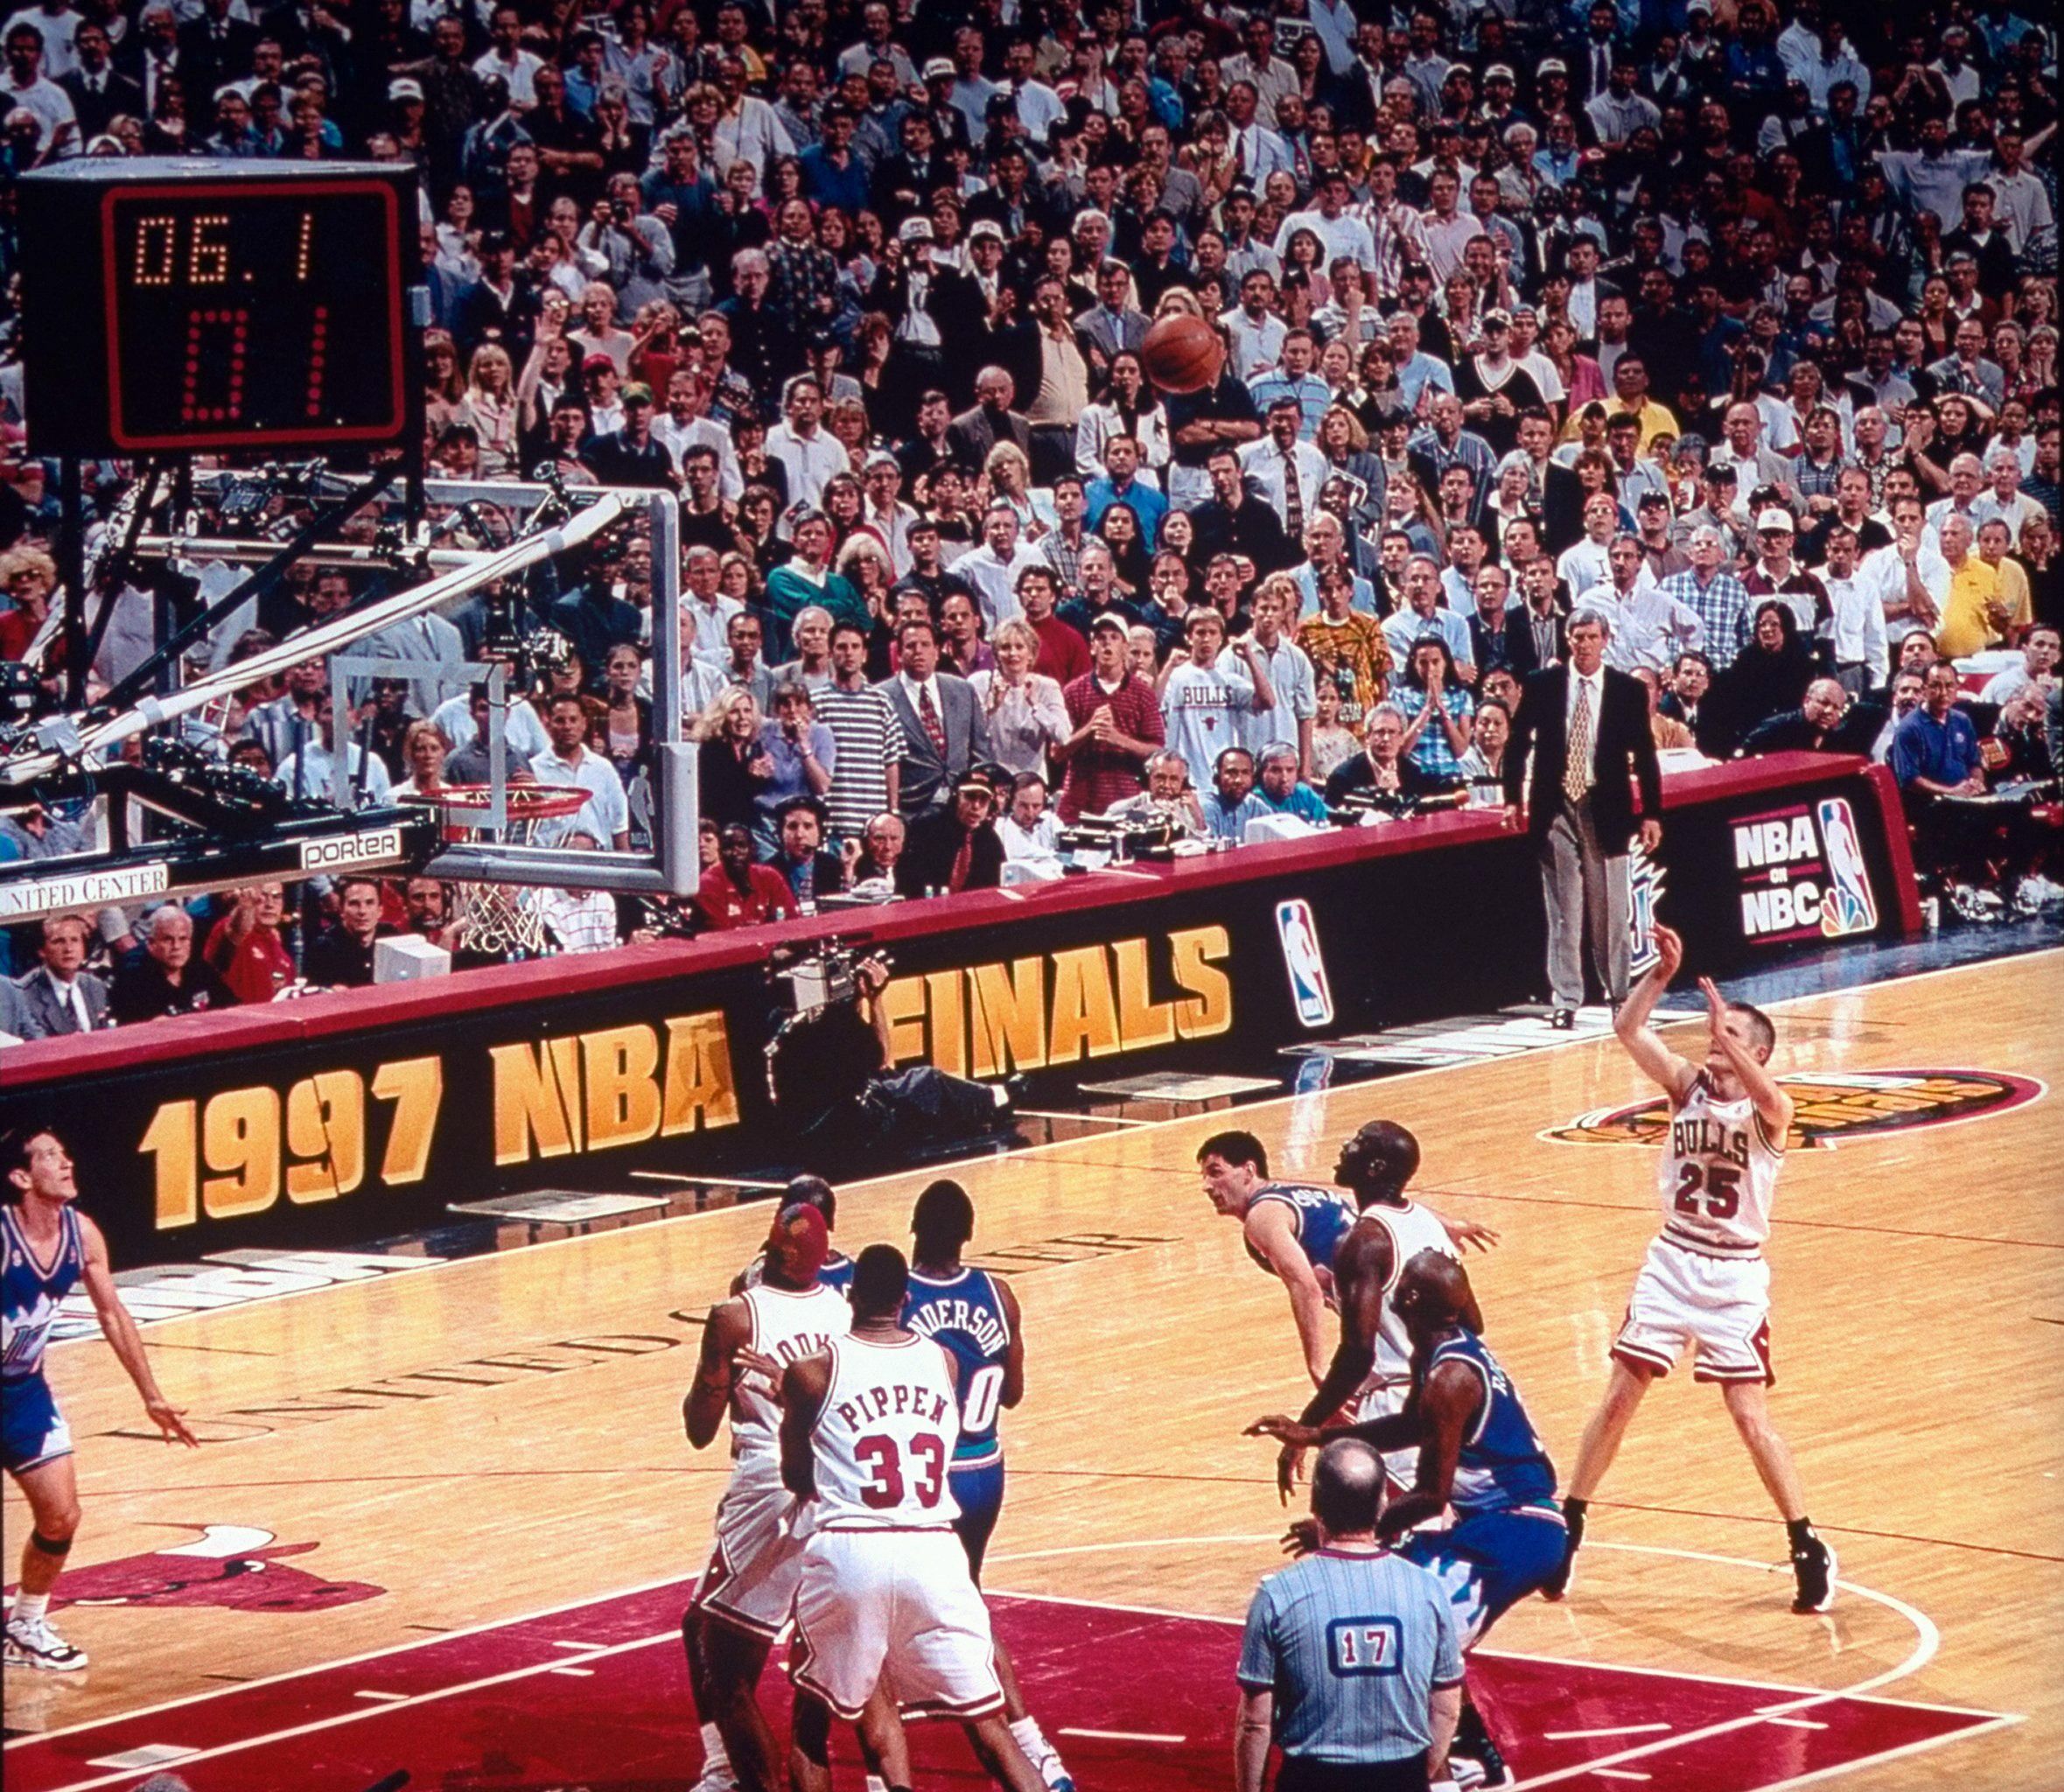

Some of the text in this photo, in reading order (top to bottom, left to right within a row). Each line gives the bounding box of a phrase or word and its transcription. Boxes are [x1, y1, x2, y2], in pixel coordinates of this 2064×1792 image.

[1183, 686, 1233, 704] BULLS
[1734, 816, 1819, 869] NBA
[0, 868, 166, 914] NITED CENTER
[1770, 867, 1788, 883] ON
[1741, 881, 1821, 935] NBC
[137, 924, 1232, 1229] 1997 NBA FINALS
[1674, 1119, 1748, 1170] BULLS
[1674, 1162, 1740, 1219] 25
[906, 1299, 1005, 1357] NDERSON
[836, 1384, 948, 1434] PIPPEN
[853, 1432, 945, 1510] 33
[1341, 1628, 1387, 1667] 17
